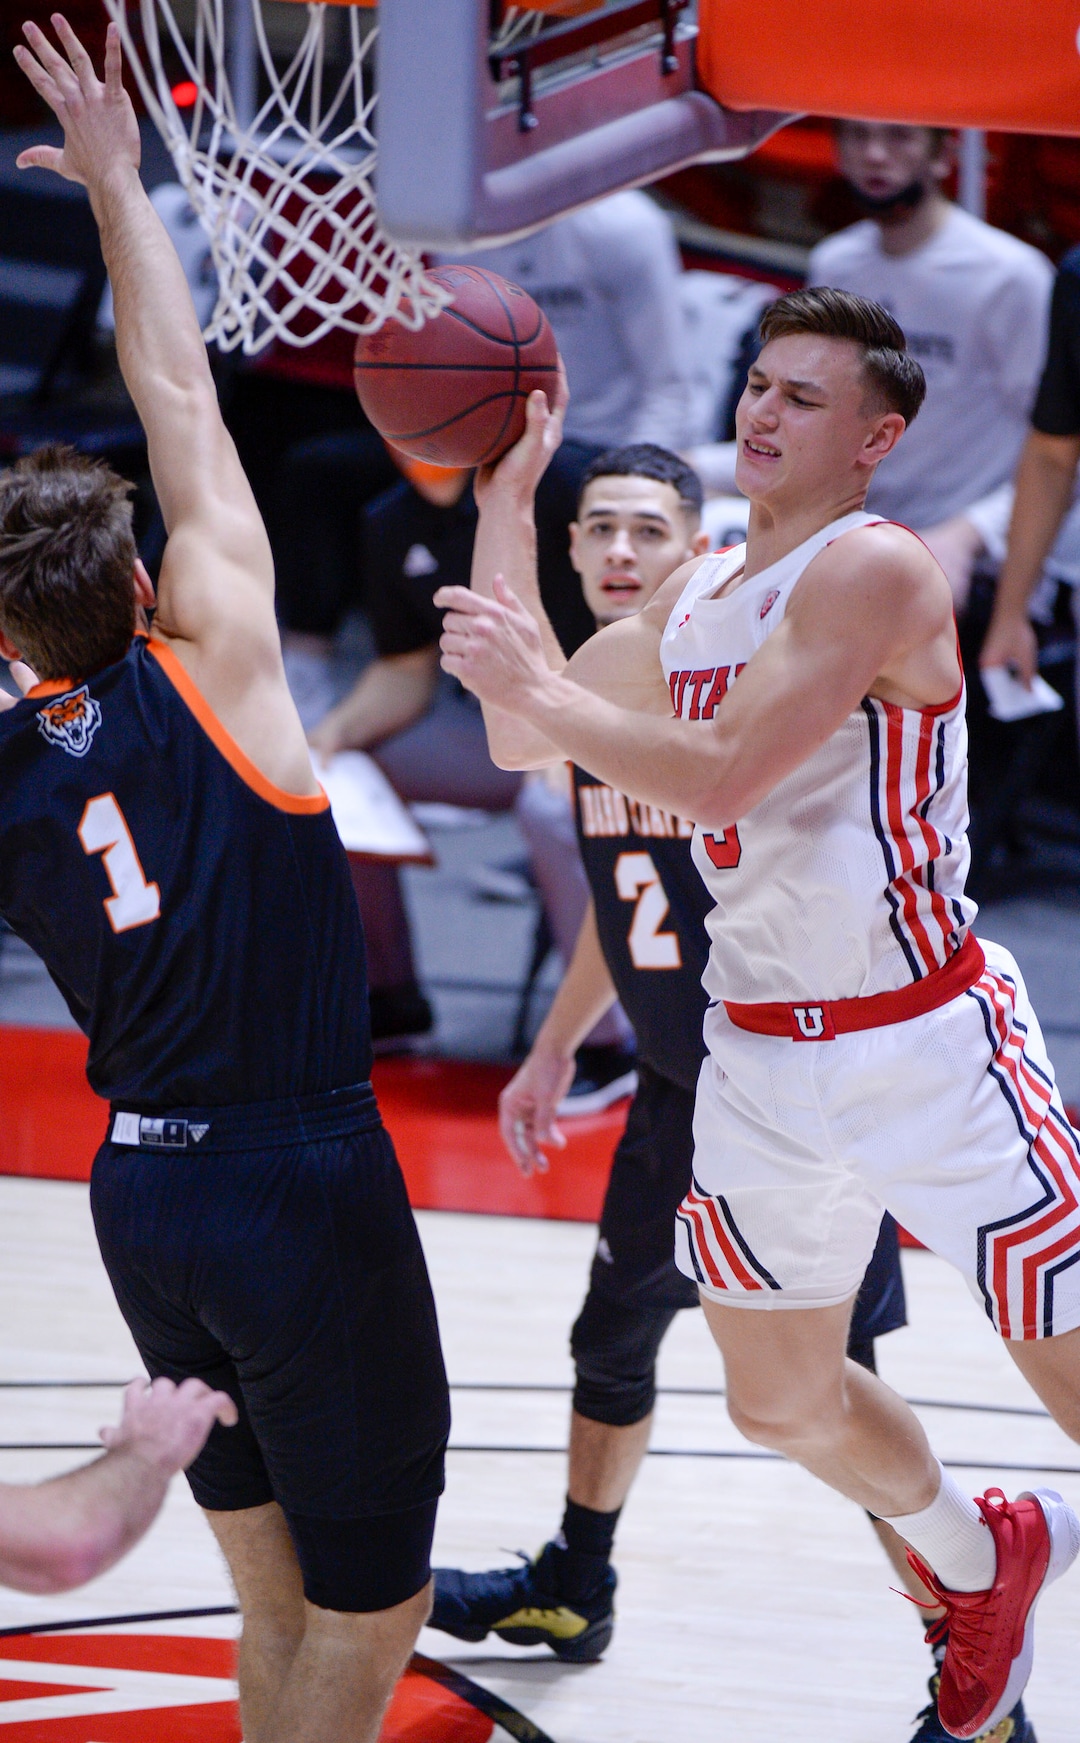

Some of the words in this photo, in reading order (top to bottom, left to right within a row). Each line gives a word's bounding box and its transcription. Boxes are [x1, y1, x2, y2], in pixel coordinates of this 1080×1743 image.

[669, 662, 748, 720] UTA
[76, 791, 161, 934] 1
[614, 850, 683, 970] 2
[792, 1006, 825, 1039] U
